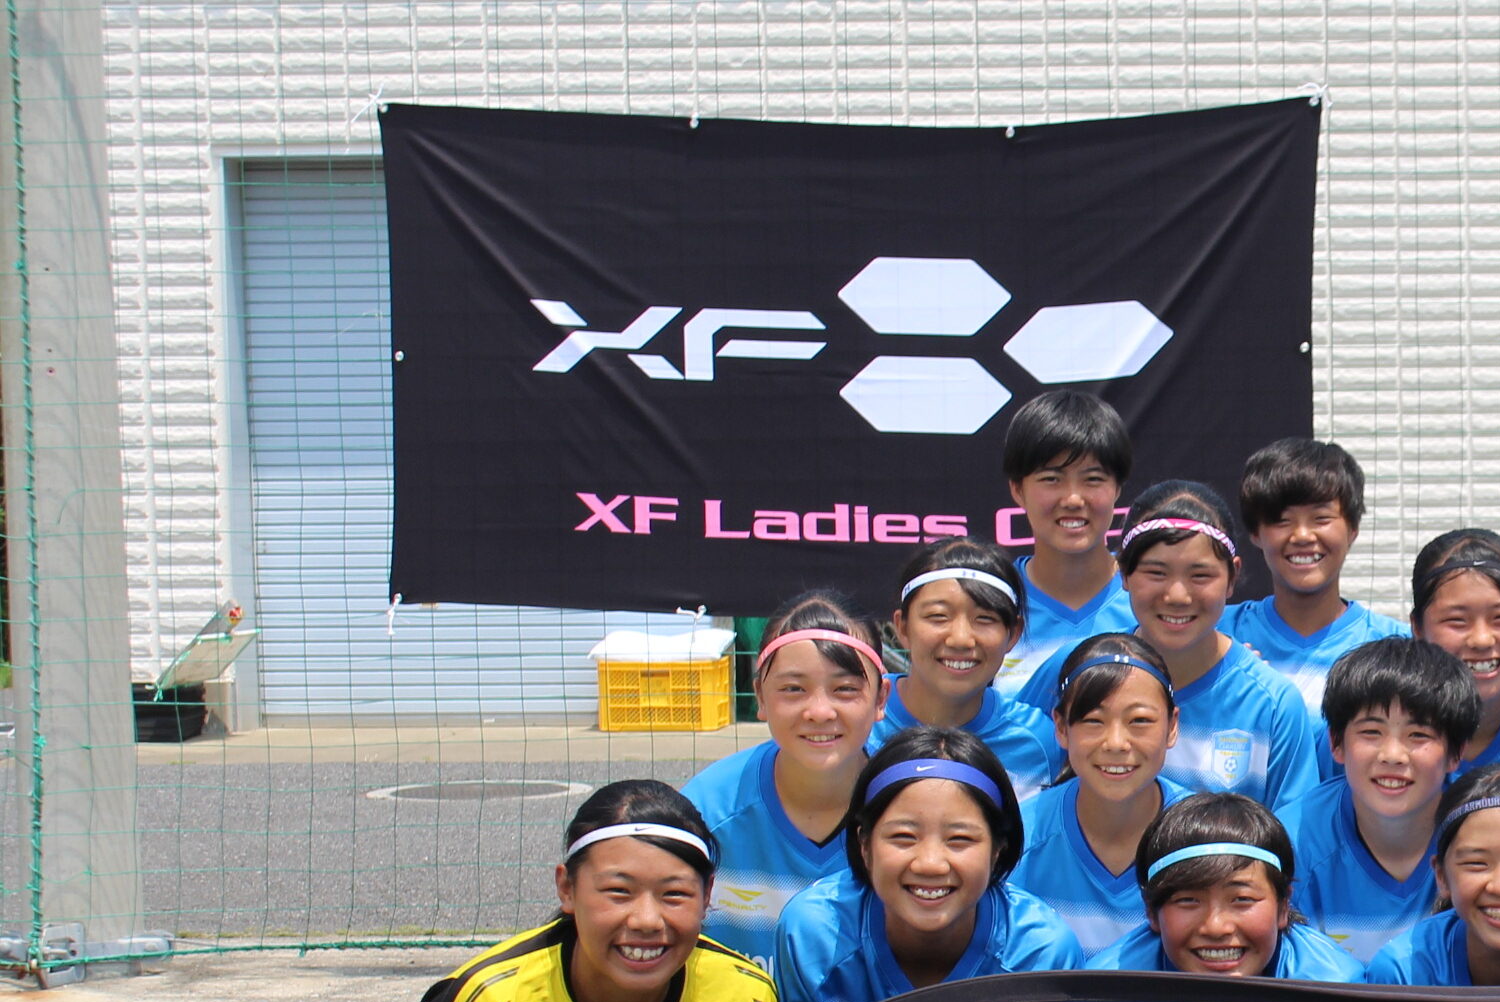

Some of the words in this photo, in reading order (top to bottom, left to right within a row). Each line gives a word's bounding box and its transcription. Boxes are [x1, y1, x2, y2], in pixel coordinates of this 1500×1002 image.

[531, 299, 826, 381] XF
[574, 492, 678, 534] XF
[704, 499, 967, 544] Ladies
